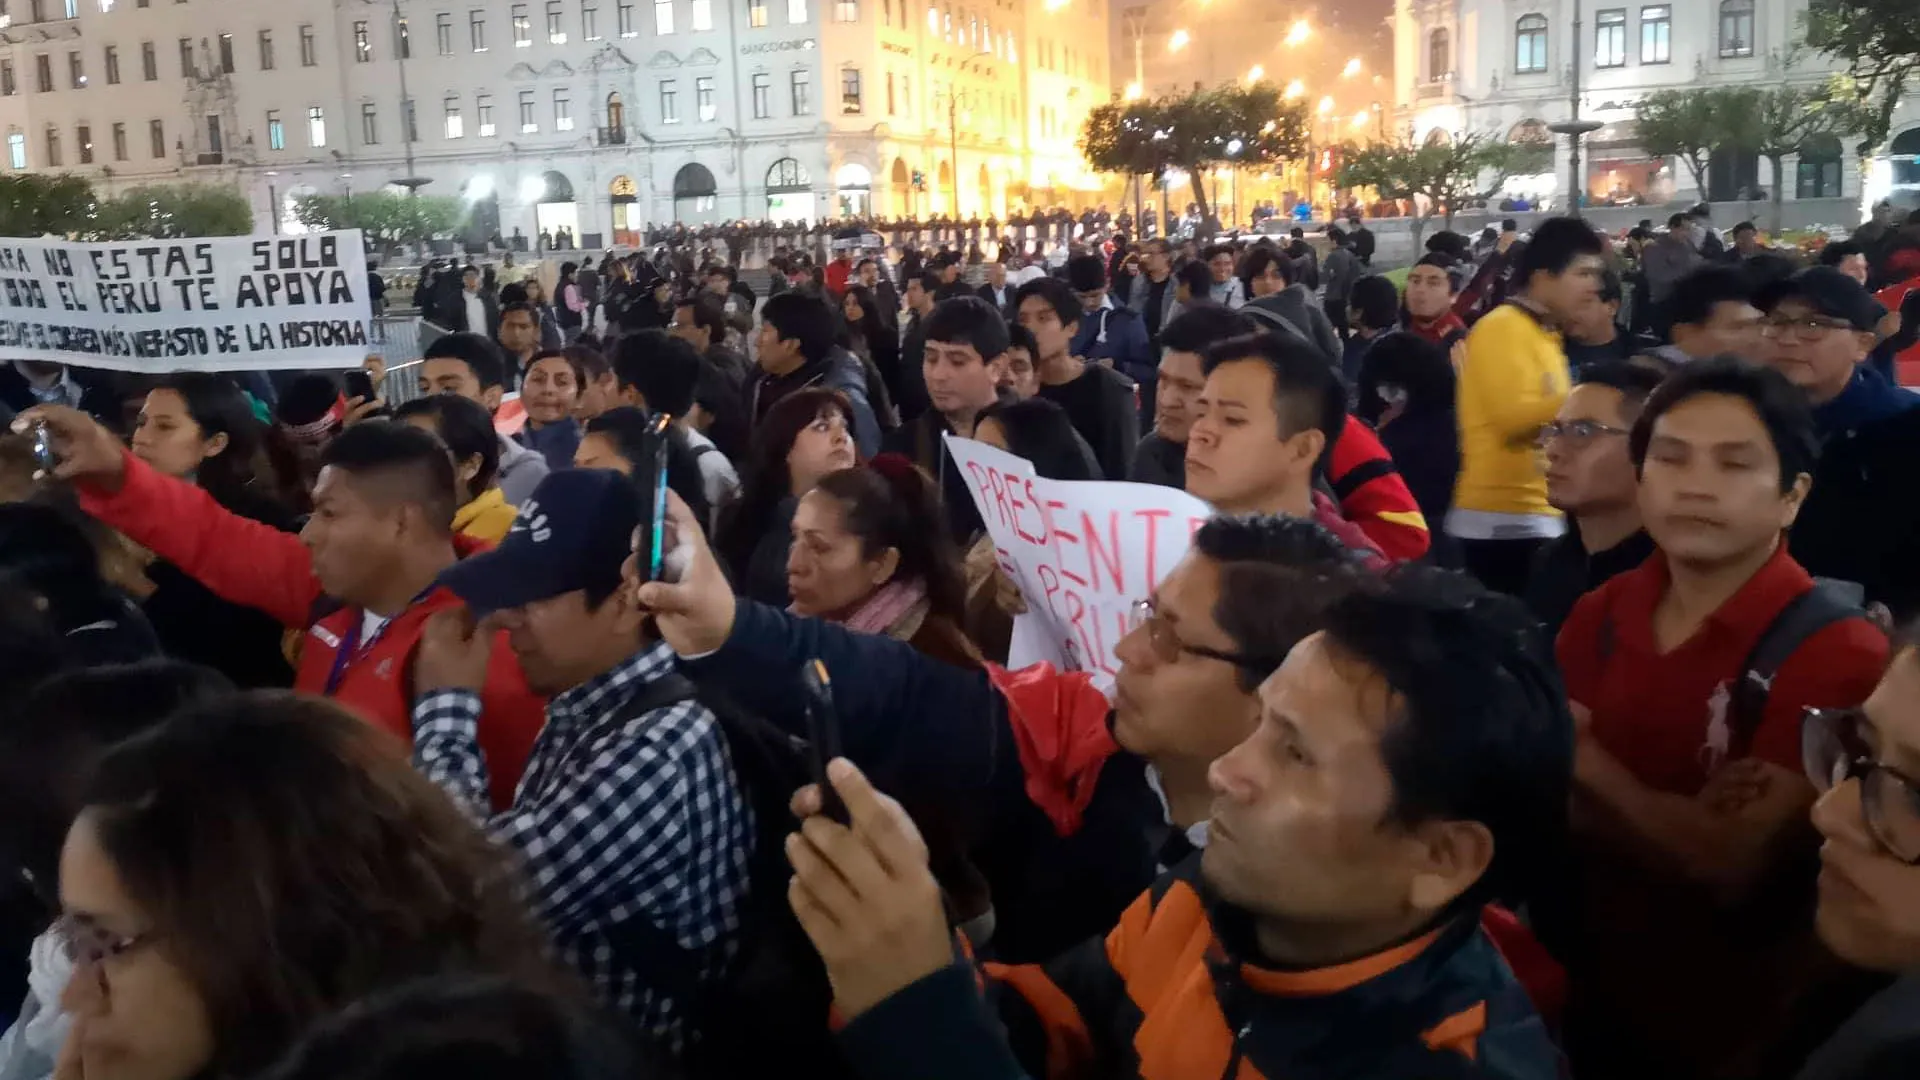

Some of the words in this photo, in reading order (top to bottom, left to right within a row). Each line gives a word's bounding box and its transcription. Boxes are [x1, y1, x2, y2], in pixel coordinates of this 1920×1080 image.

[43, 248, 74, 277] NO
[90, 243, 214, 280] ESTAS
[253, 236, 338, 271] SOLO
[0, 278, 47, 309] ODO
[56, 281, 88, 312] EL
[173, 277, 219, 311] TE
[236, 270, 354, 308] APOYA
[129, 326, 209, 358] NEFASTO
[214, 323, 239, 353] DE
[246, 322, 275, 351] LA
[279, 319, 367, 349] HISTORIA
